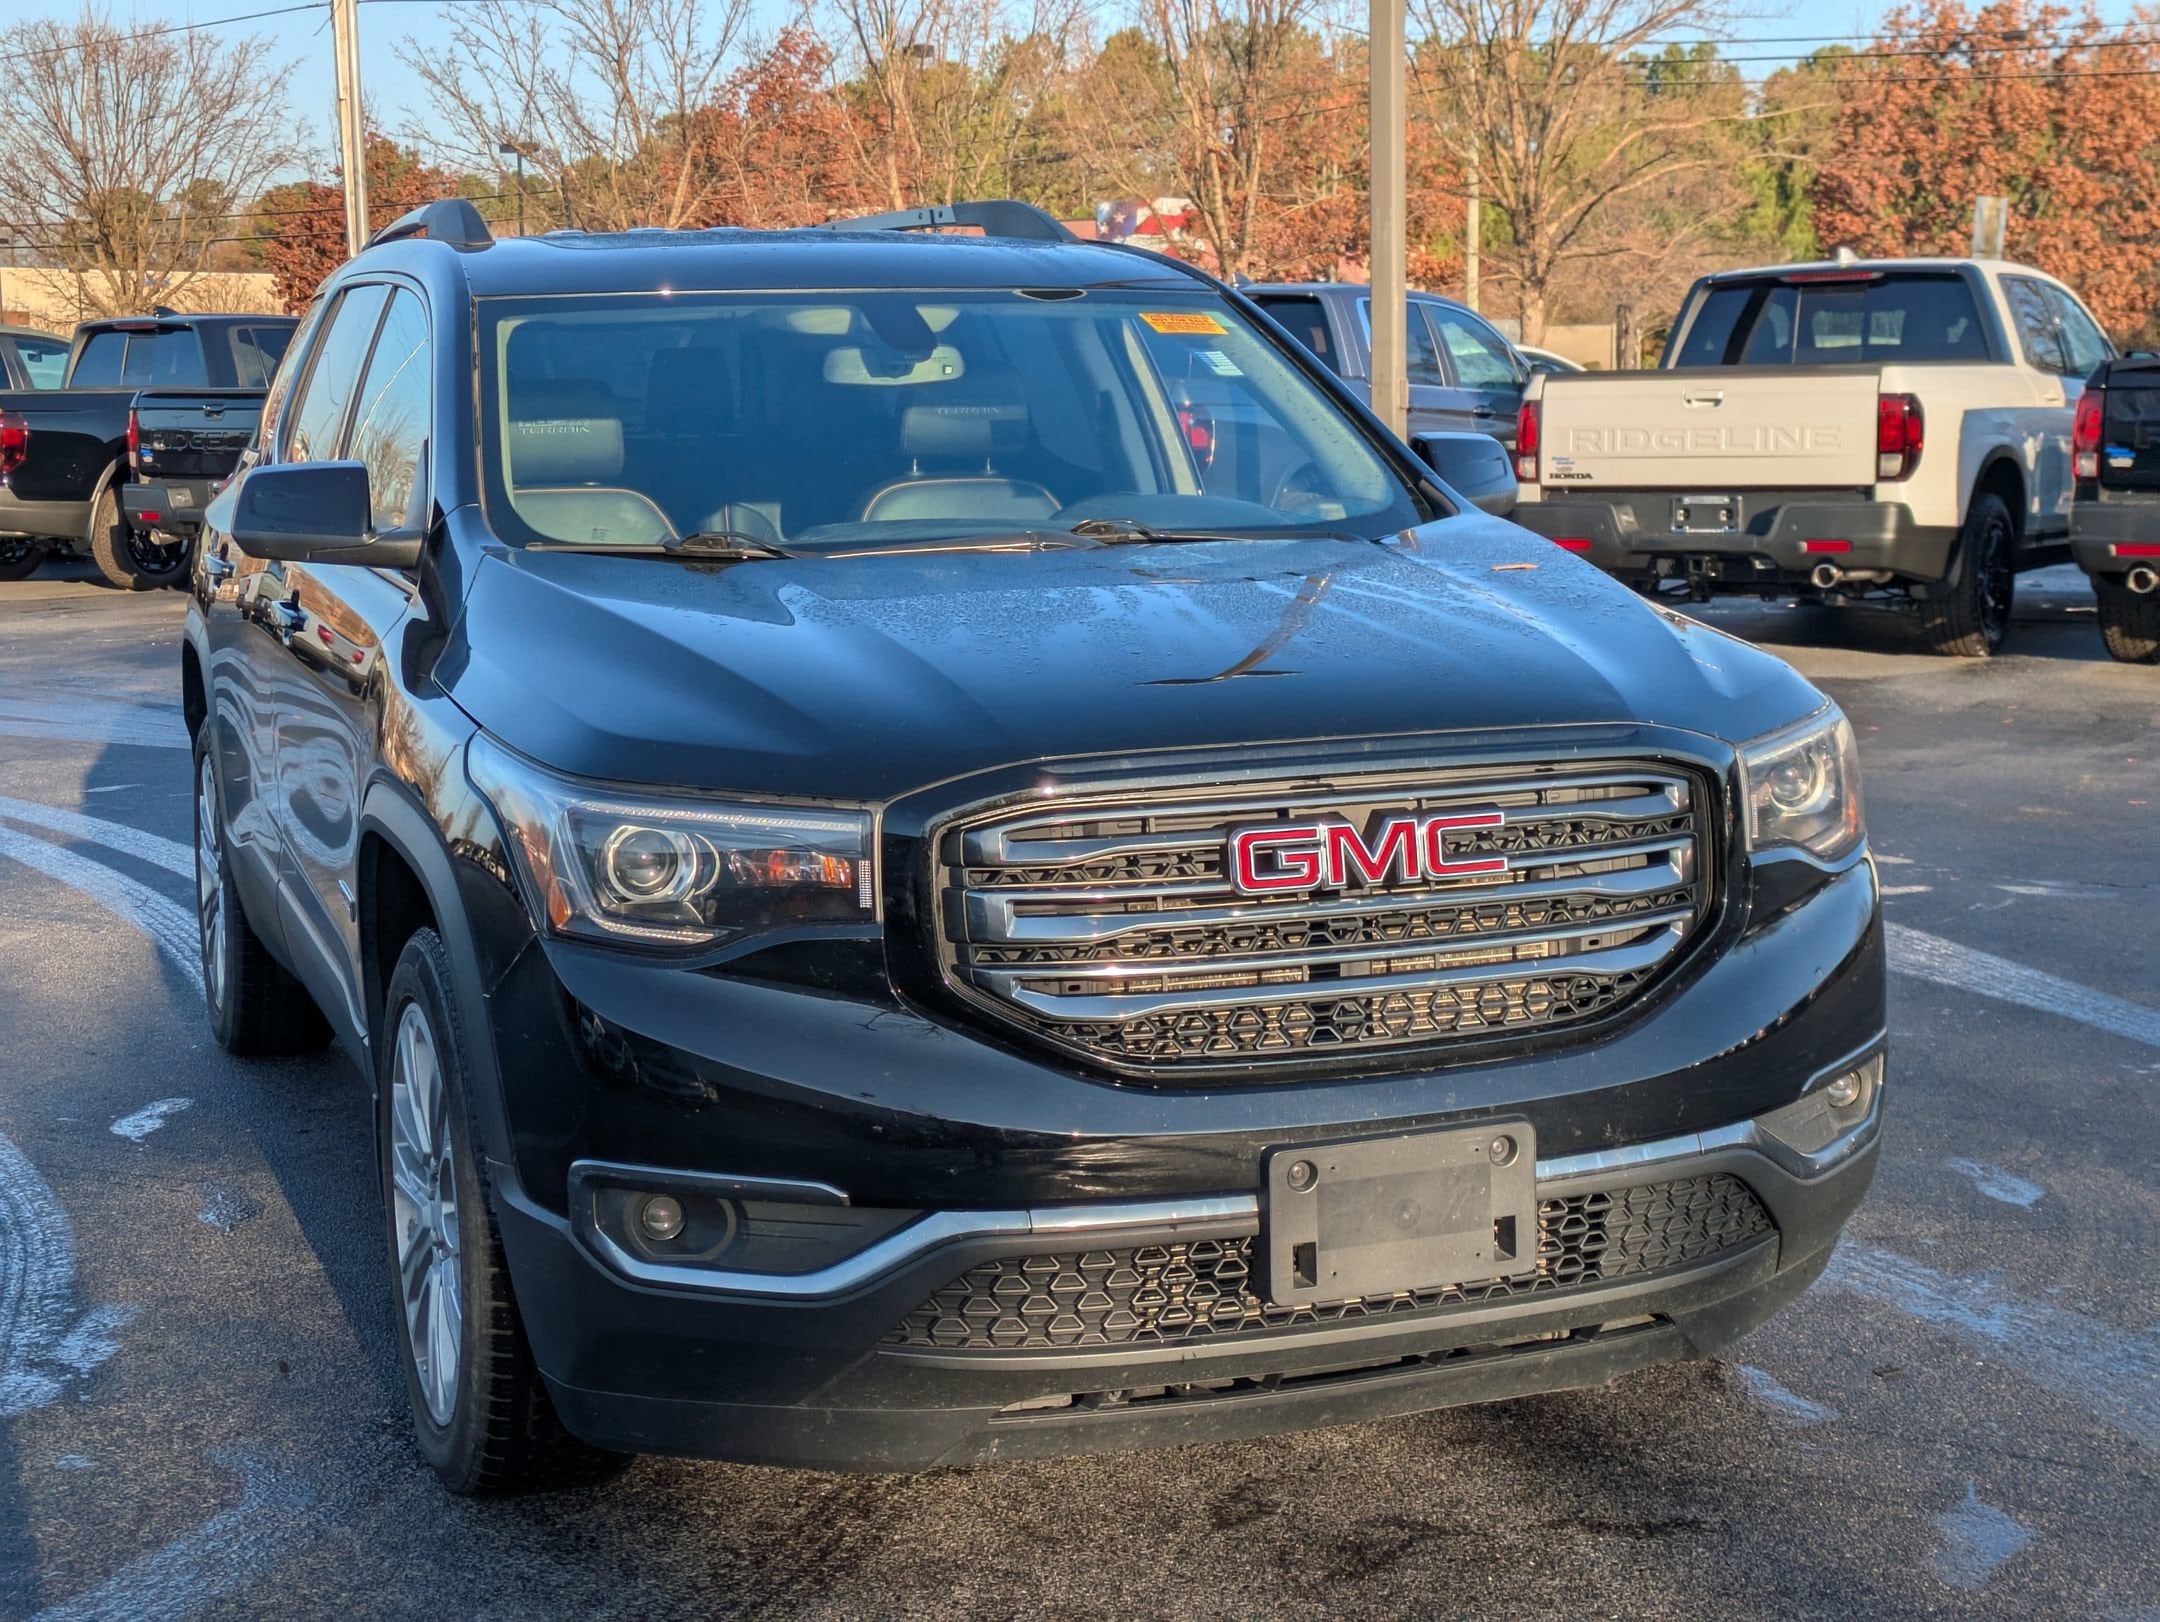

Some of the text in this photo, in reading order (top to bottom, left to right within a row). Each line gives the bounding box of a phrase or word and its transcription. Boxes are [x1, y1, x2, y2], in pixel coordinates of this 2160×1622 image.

[519, 425, 591, 435] TERRAIN
[1568, 426, 1842, 453] RIDGELINE
[1549, 472, 1594, 480] HONDA
[1228, 806, 1508, 895] GMC
